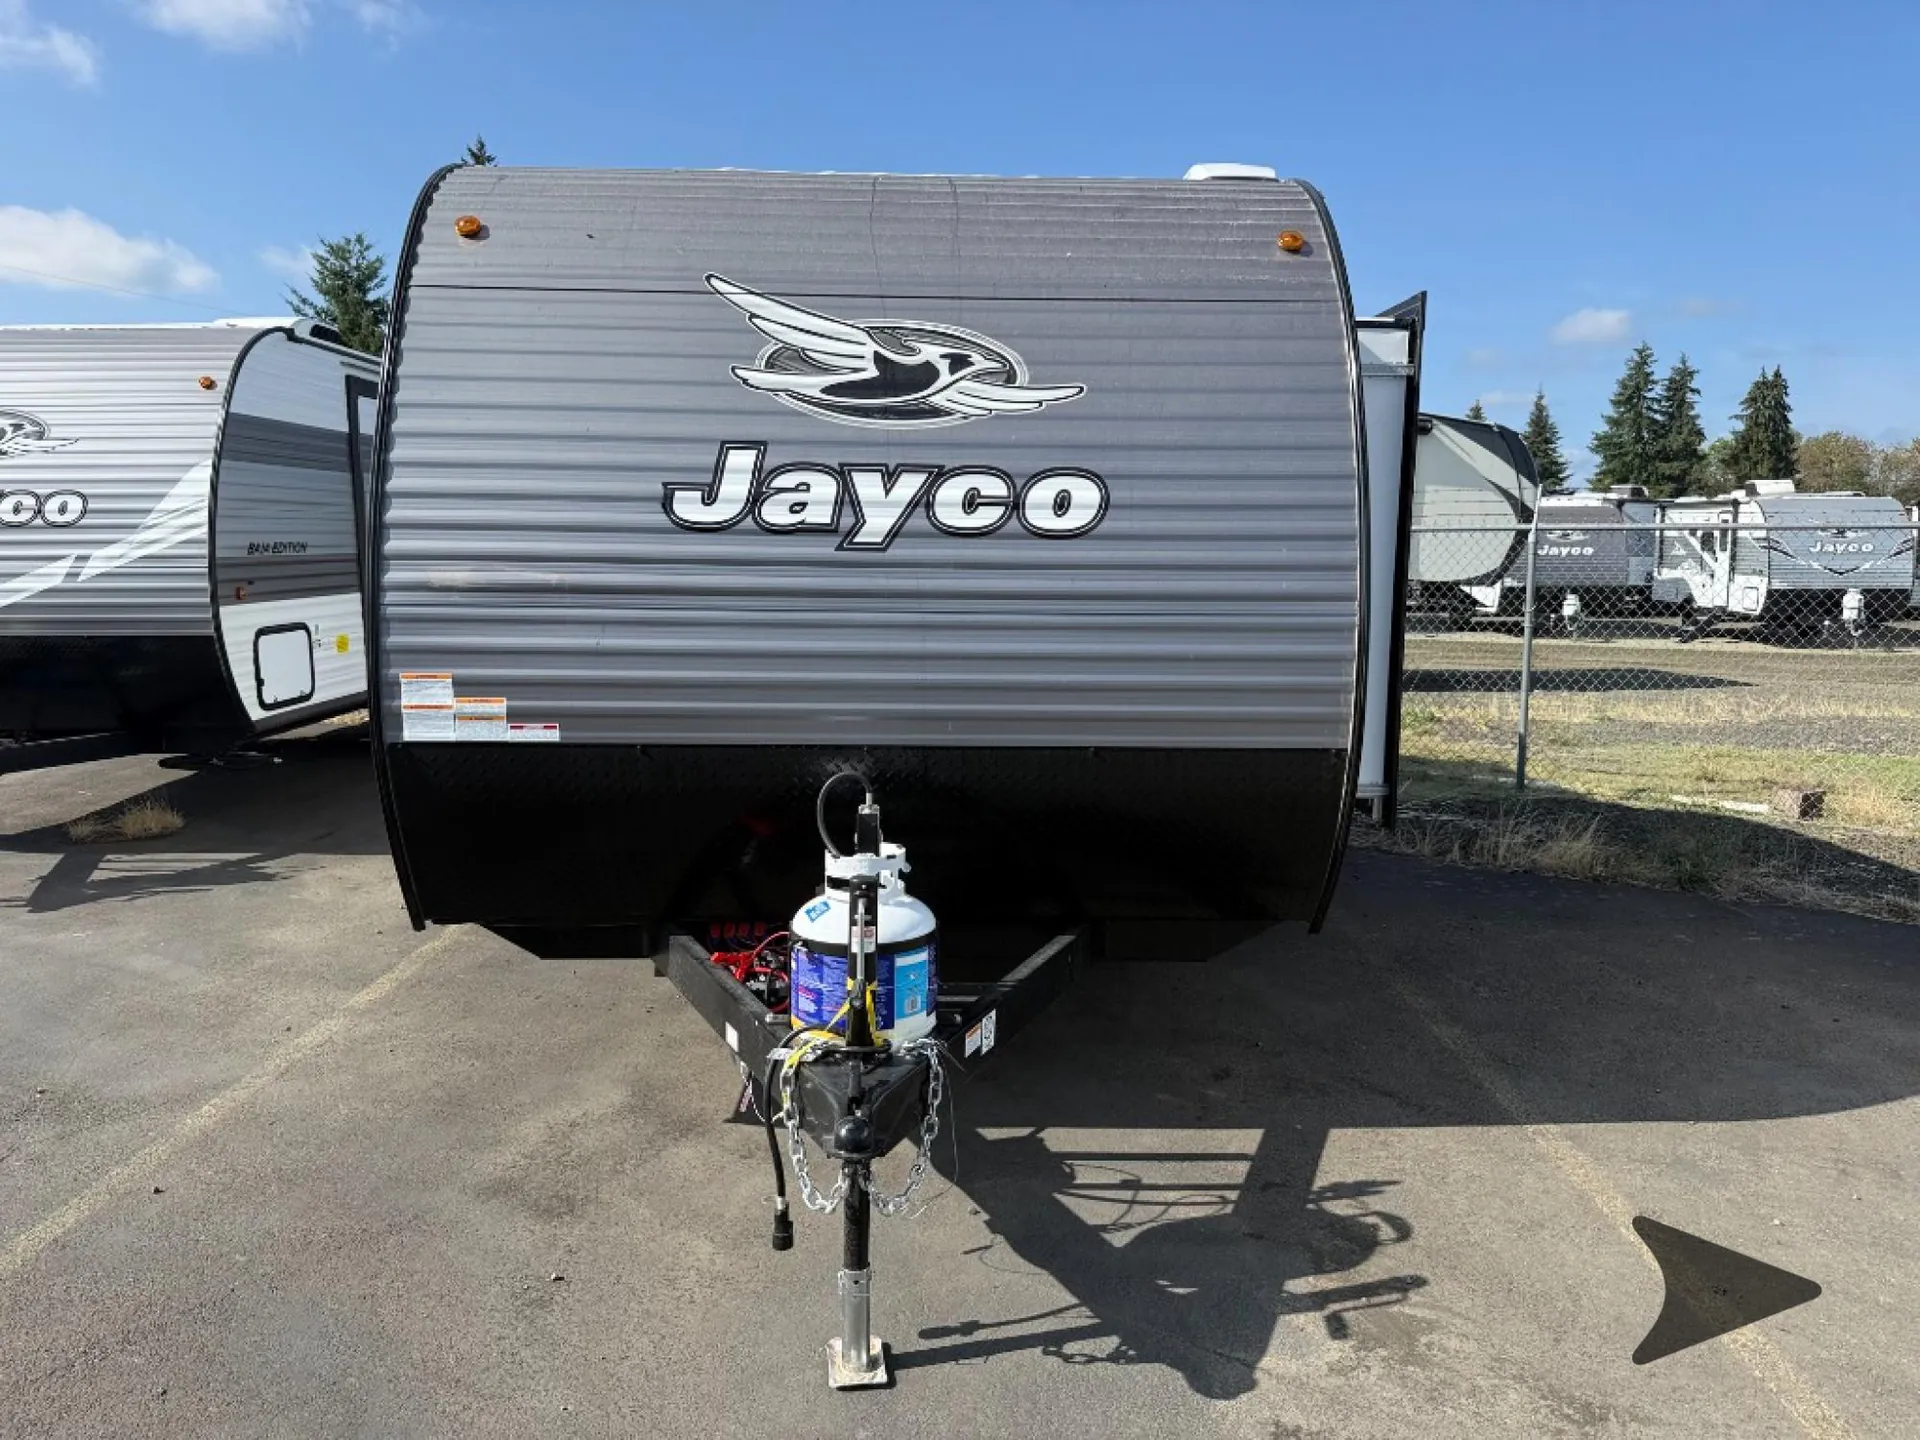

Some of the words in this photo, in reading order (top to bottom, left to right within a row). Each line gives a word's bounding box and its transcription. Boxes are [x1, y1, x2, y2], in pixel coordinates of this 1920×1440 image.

[661, 440, 1110, 551] Jayco
[0, 489, 88, 527] co
[271, 541, 308, 554] EDITION
[1537, 544, 1594, 558] Jayco
[1808, 541, 1874, 554] Jayco
